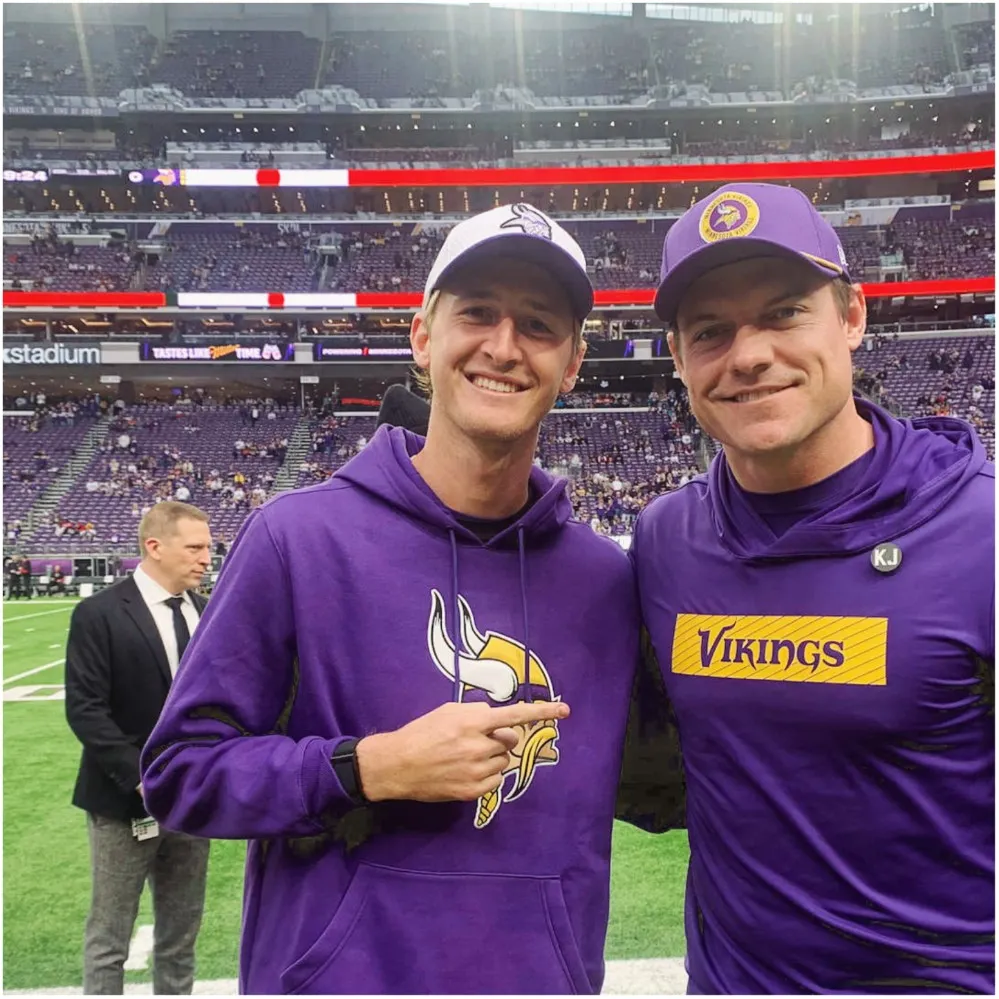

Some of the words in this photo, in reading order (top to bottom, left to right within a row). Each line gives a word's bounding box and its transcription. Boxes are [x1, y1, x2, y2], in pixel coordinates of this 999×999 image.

[152, 347, 188, 359] TASTES
[189, 347, 210, 359] LIKE
[874, 549, 898, 566] KJ
